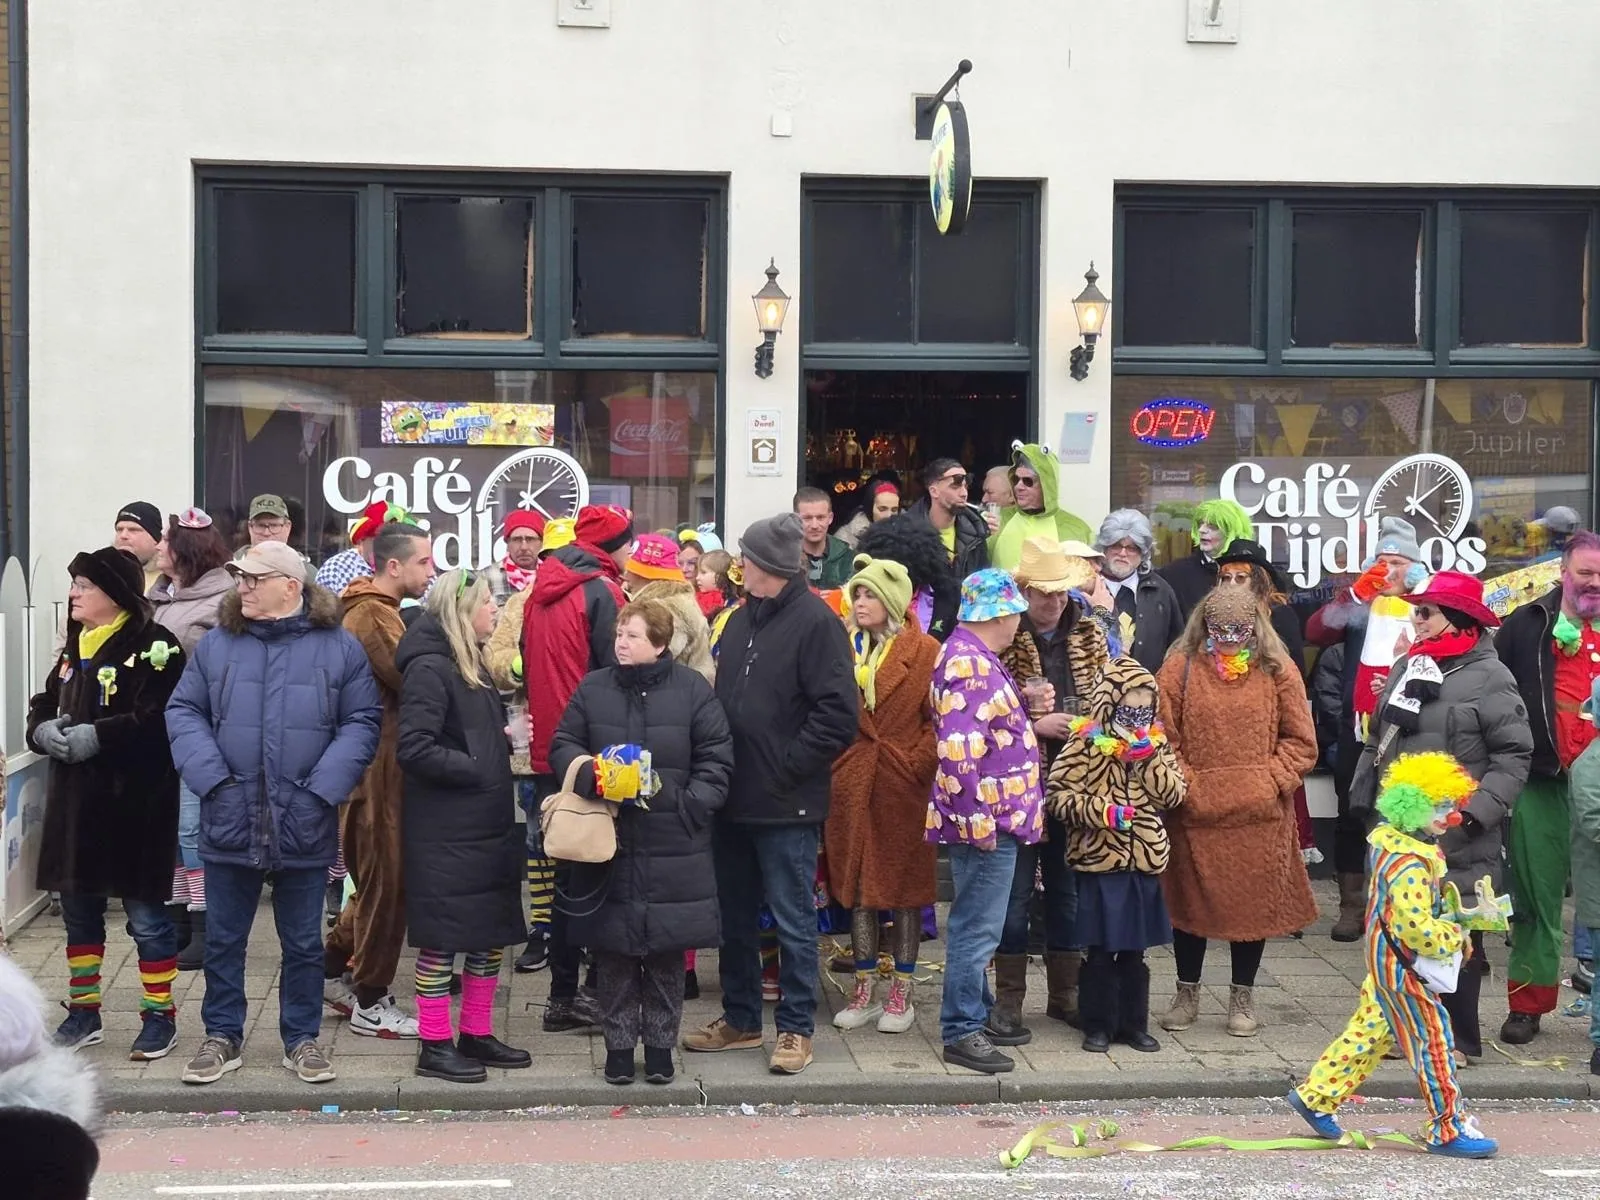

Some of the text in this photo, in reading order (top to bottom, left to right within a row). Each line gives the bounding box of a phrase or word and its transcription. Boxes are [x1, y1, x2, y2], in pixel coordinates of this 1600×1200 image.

[445, 426, 468, 440] UIT
[1132, 408, 1214, 438] OPEN
[1463, 429, 1565, 458] Jupiler
[323, 456, 471, 514] Café
[1220, 462, 1360, 518] Café
[1249, 512, 1487, 589] Tijdlos
